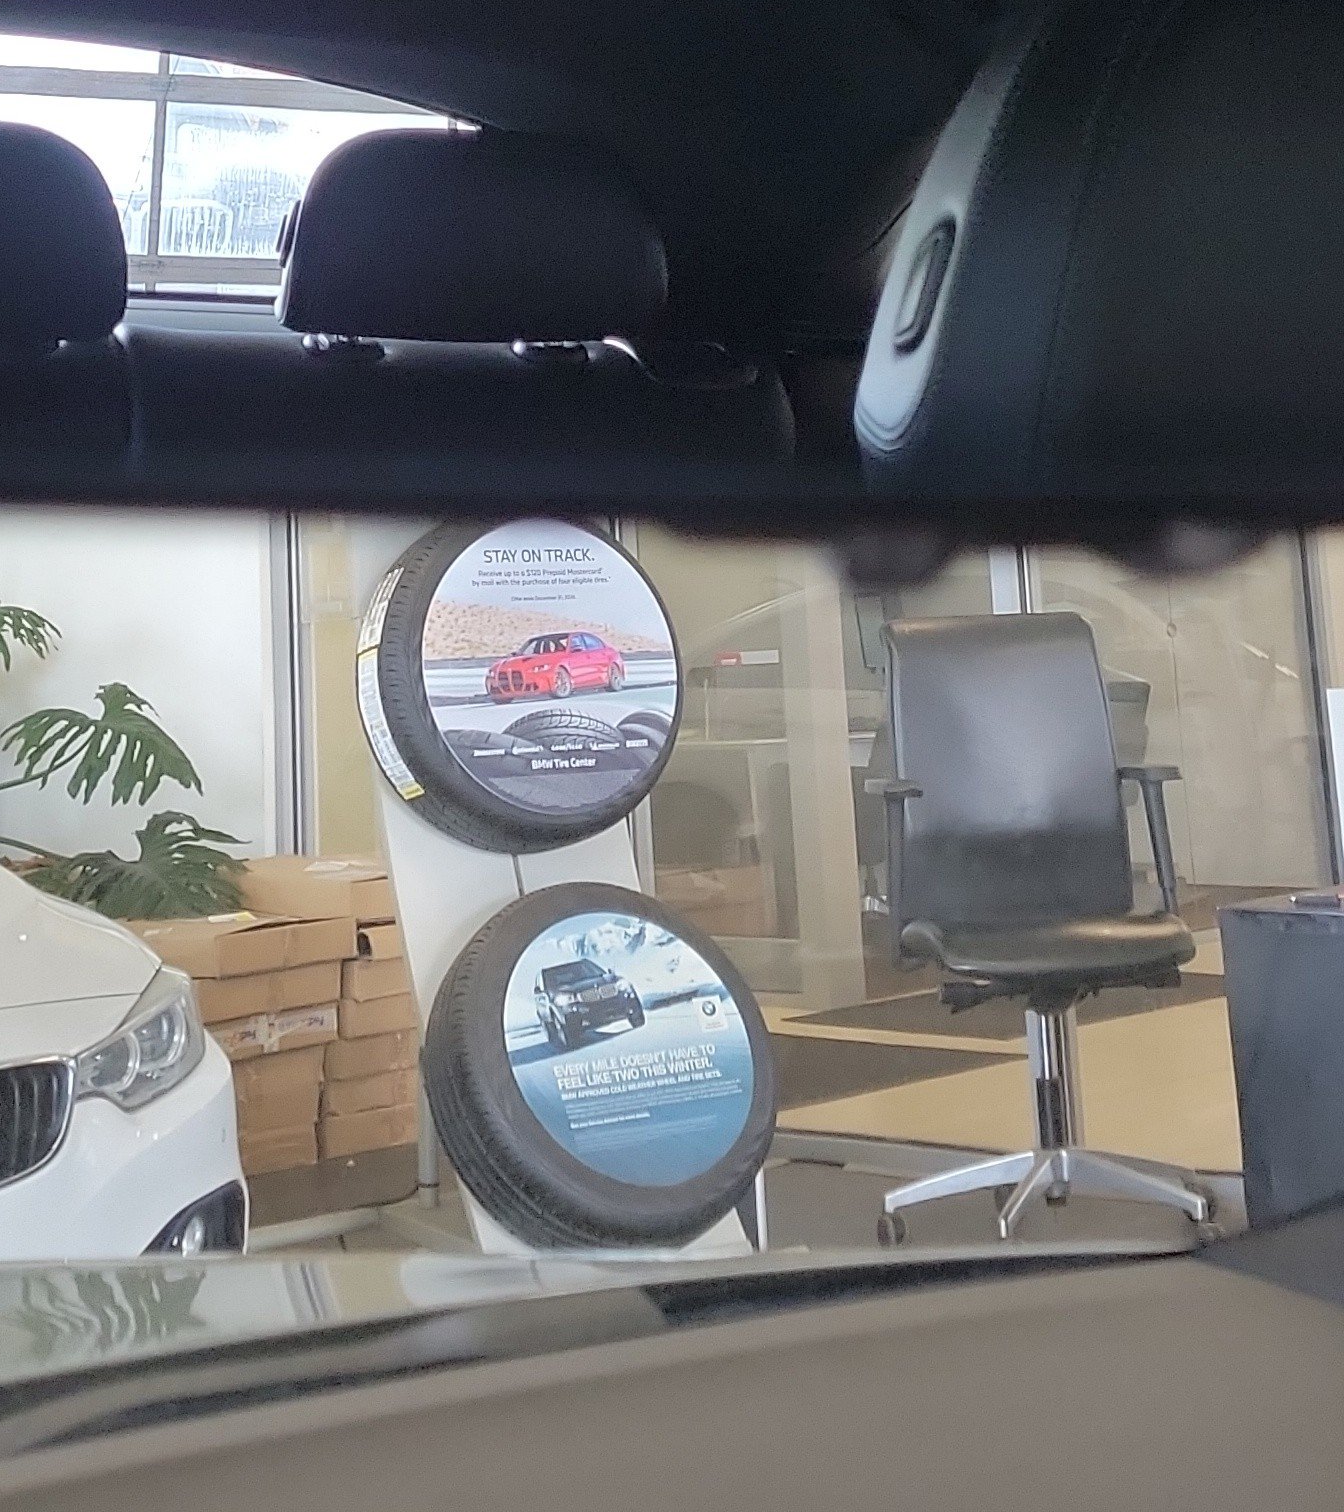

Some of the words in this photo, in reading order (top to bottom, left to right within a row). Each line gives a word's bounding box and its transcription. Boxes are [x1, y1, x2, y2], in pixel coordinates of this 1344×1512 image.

[483, 549, 517, 563] STAY
[521, 549, 542, 563] ON
[544, 548, 595, 562] TRACK.
[554, 758, 570, 769] Tire
[570, 757, 596, 768] Center
[554, 1061, 589, 1078] EVERY
[592, 1056, 619, 1074] MILE
[668, 1047, 699, 1063] HAVE
[700, 1043, 716, 1056] TO
[558, 1076, 587, 1090] FEEL
[586, 1071, 611, 1086] LIKE
[613, 1067, 640, 1082] TWO
[641, 1063, 668, 1078] THIS
[667, 1056, 713, 1074] WINTER.
